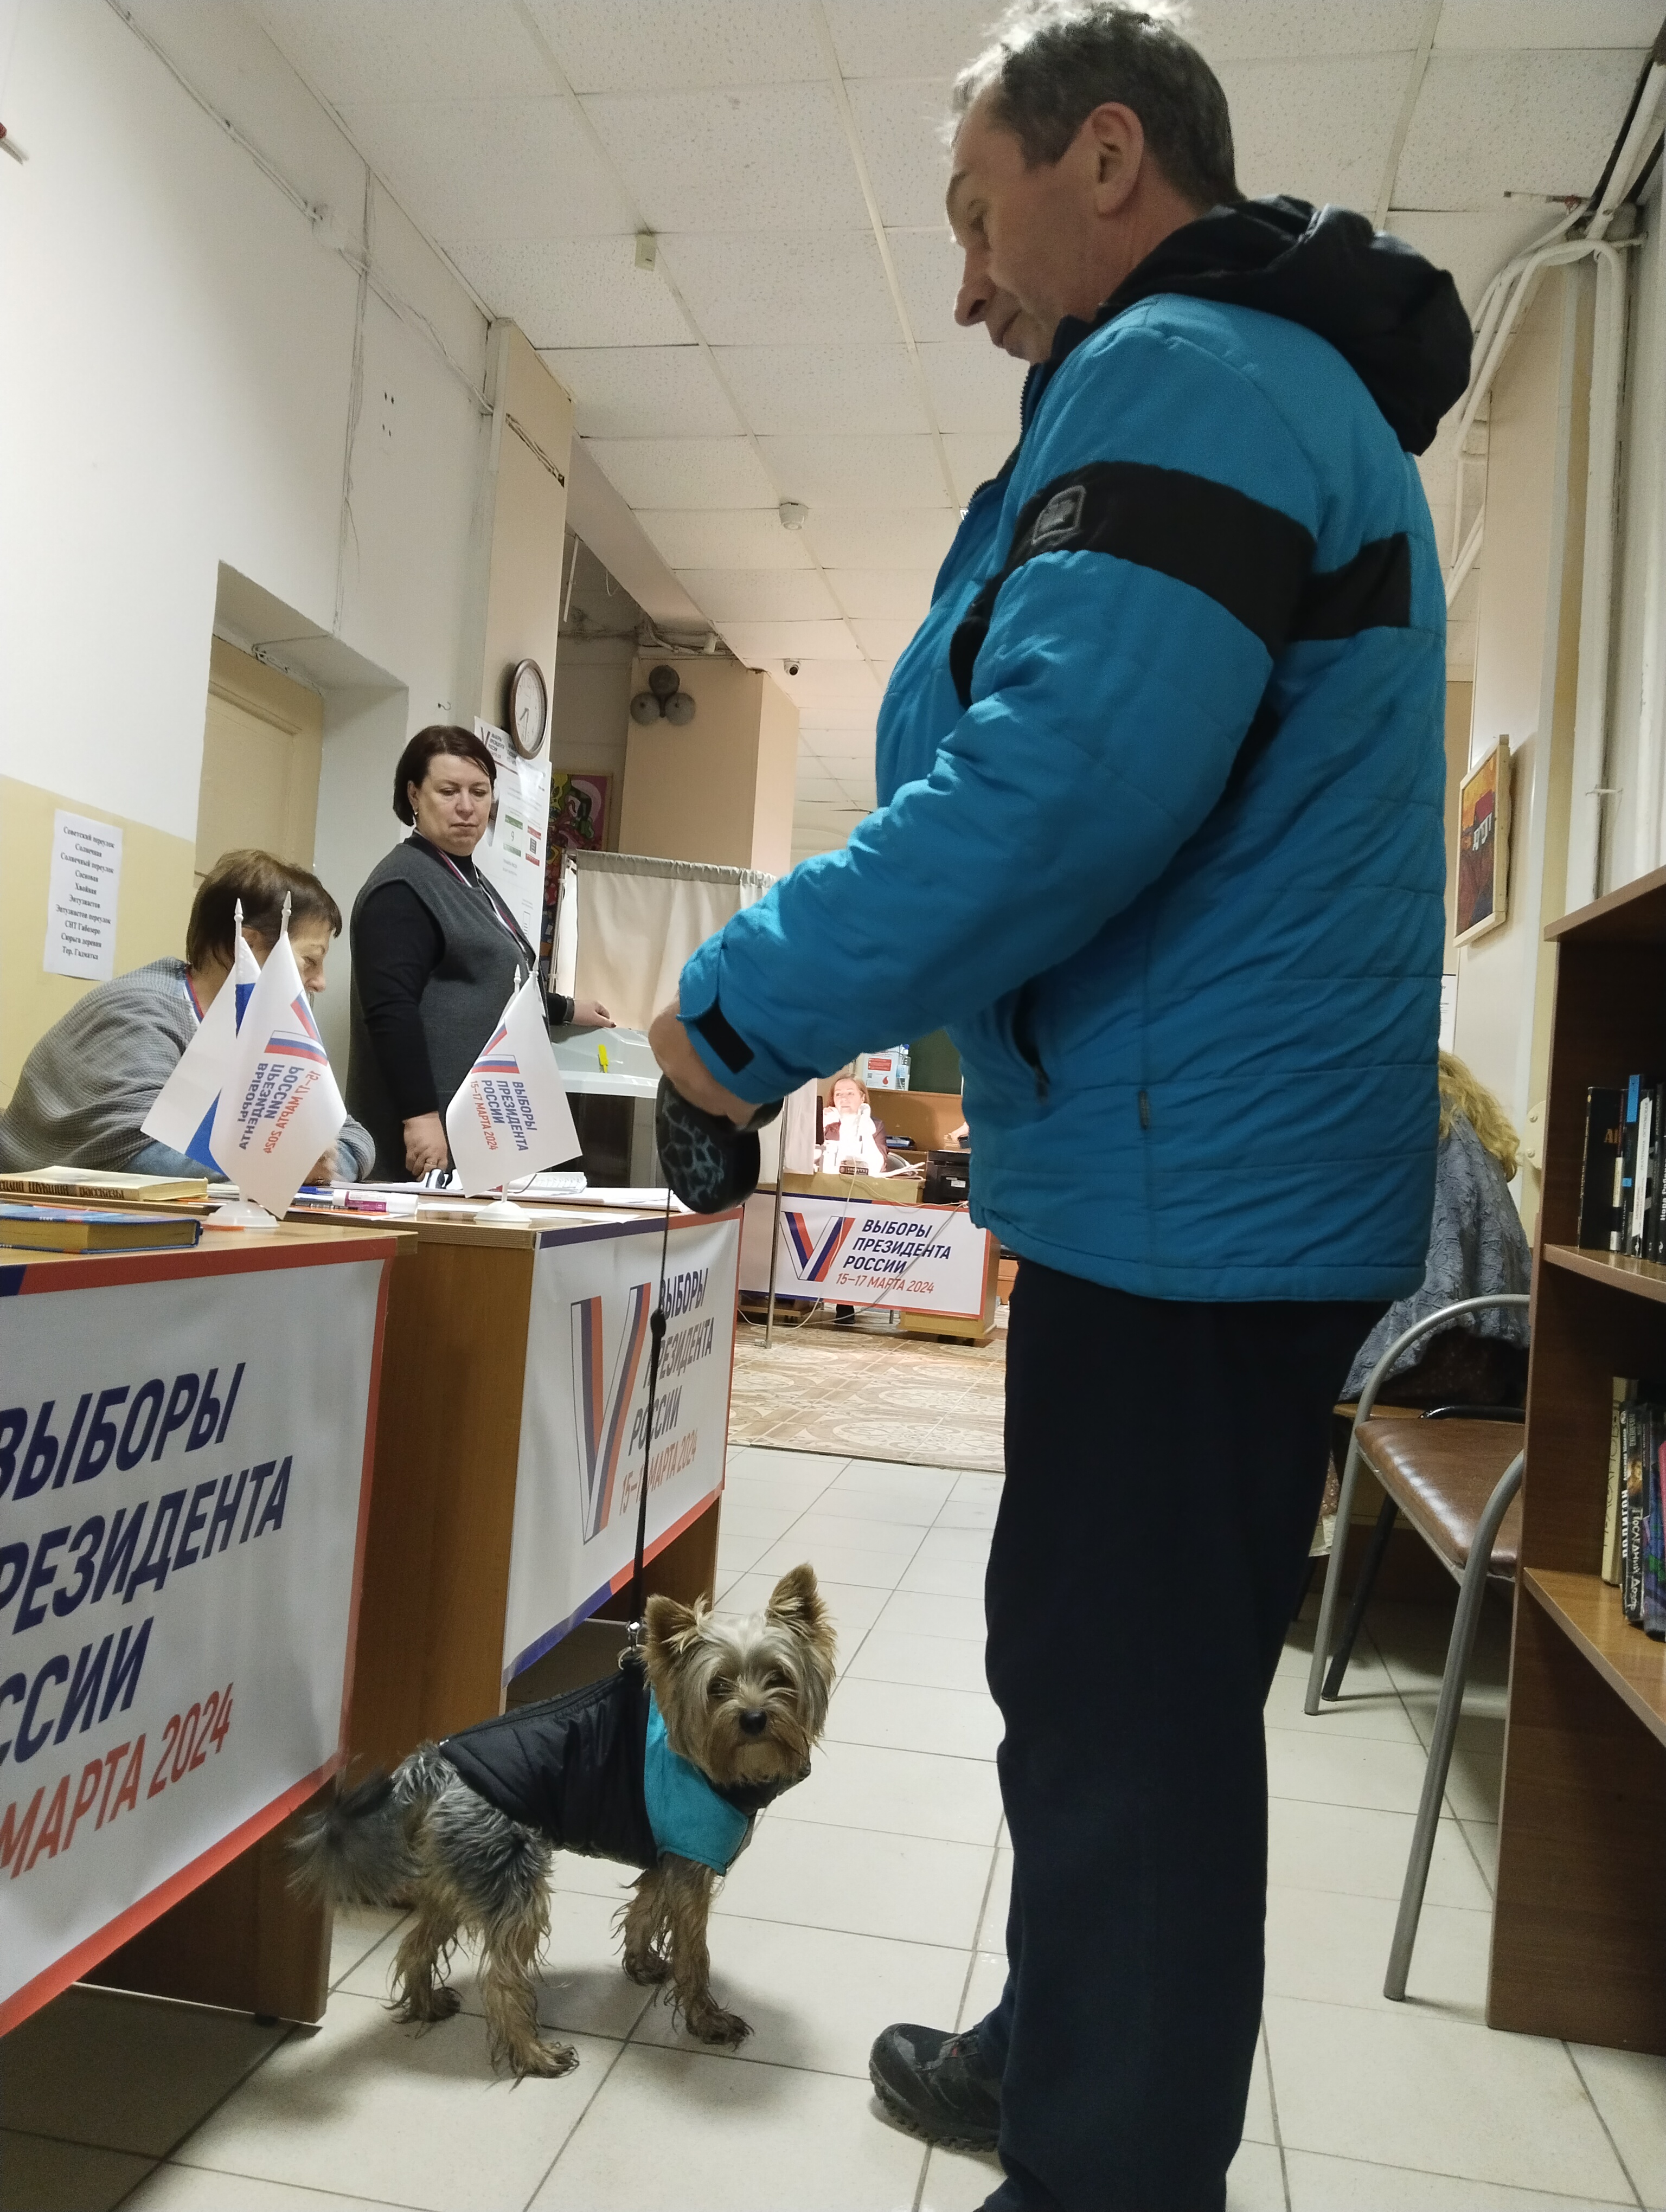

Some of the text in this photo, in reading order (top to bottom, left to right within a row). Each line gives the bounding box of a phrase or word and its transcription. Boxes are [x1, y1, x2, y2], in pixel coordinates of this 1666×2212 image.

[63, 826, 115, 849] Советский переулок
[75, 843, 102, 858] Солнечная
[60, 852, 114, 874] Солнечный переулок
[75, 869, 99, 882] Сосновая
[75, 882, 97, 895] Хвойная
[68, 894, 101, 909] Энтузиастов
[55, 904, 111, 924] Энтузиастов переулок
[65, 920, 78, 929] СНТ
[62, 946, 73, 956] Тер.
[82, 938, 102, 948] деревня
[482, 1080, 505, 1124] РОССИИ
[512, 1081, 537, 1131] ВЫБОРЫ
[475, 1102, 491, 1129] МАРТА
[484, 1131, 498, 1150] 2024
[496, 1080, 529, 1151] ПРЕЗИДЕНТА
[862, 1219, 933, 1238] ВЫБОРЫ
[853, 1237, 951, 1260] ПРЕЗИДЕНТА
[843, 1255, 907, 1274] РОССИИ
[658, 1268, 708, 1321] ВЫБОРЫ
[868, 1276, 905, 1291] МАРТА
[906, 1280, 934, 1294] 2024
[0, 1362, 246, 1502] ВЫБОРЫ
[677, 1427, 698, 1474] 2024
[0, 1682, 234, 1880] МАРТА 2024
